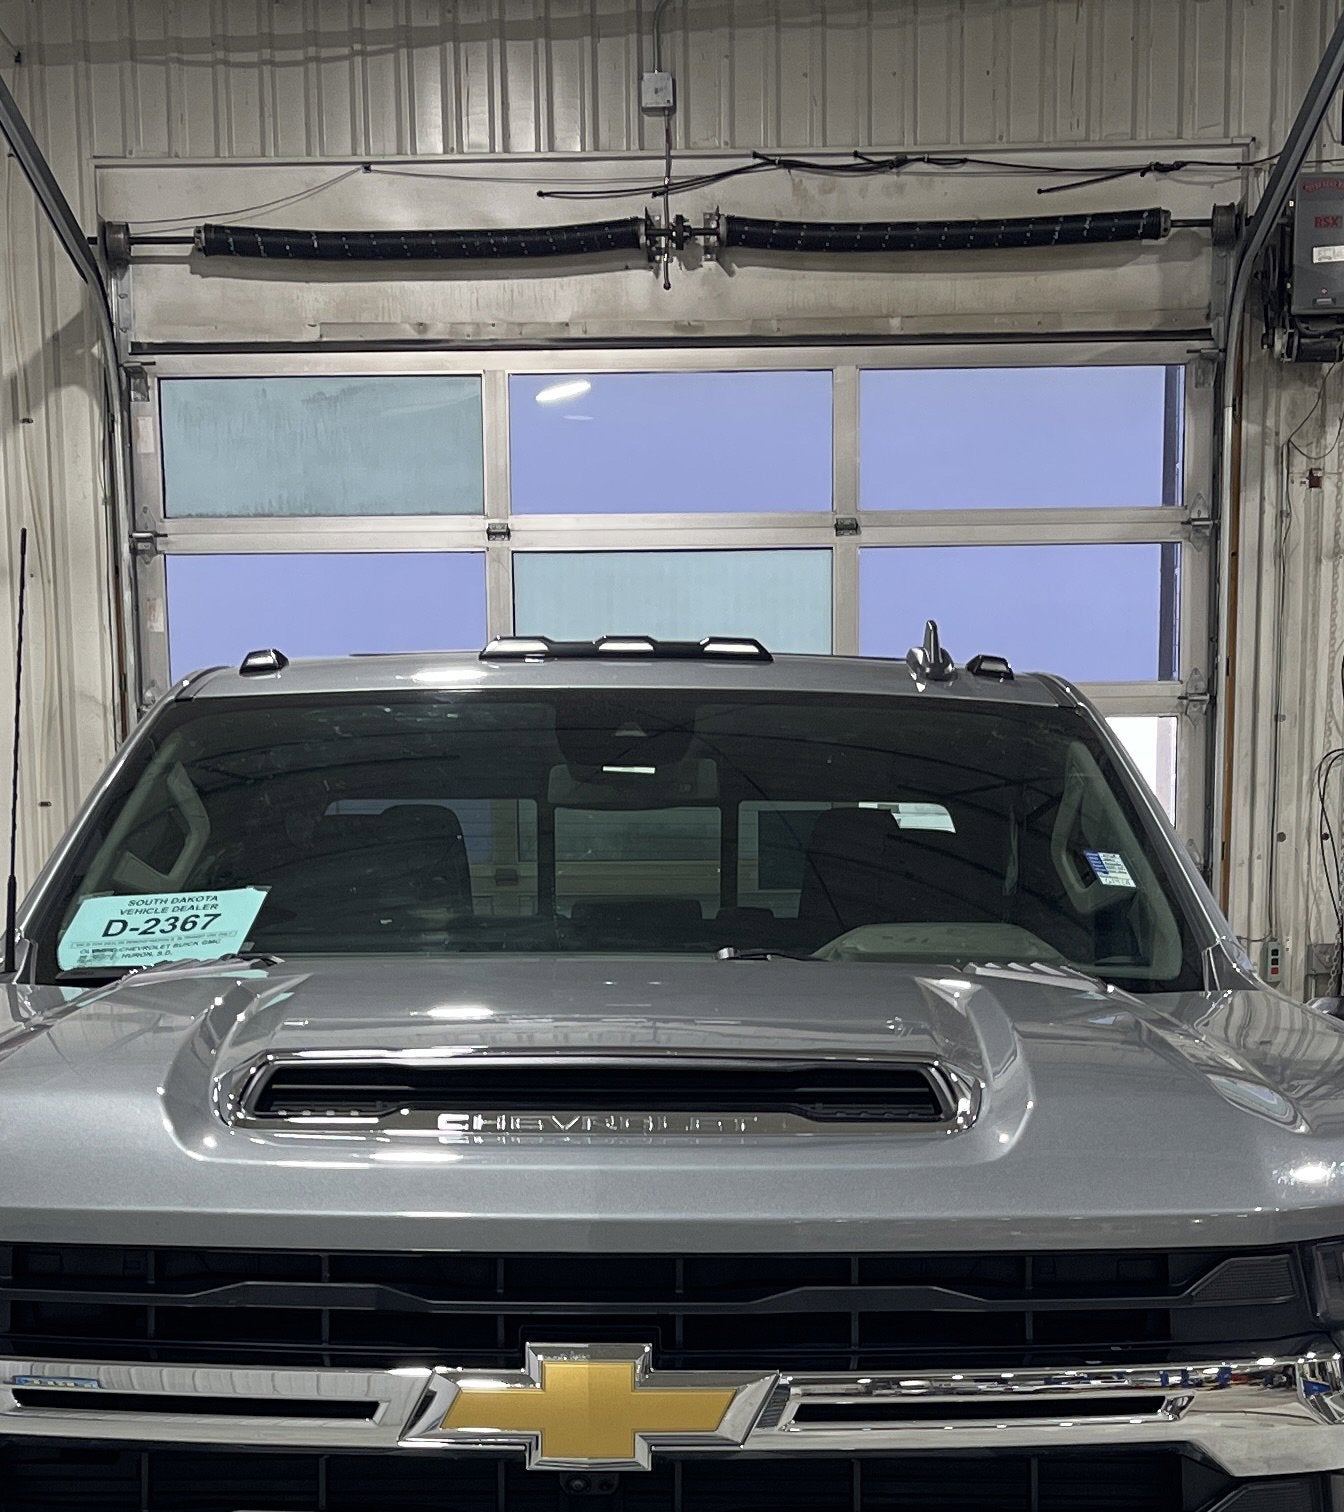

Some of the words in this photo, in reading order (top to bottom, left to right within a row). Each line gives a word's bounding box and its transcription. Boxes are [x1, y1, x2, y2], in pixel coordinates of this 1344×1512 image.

[128, 897, 168, 907] SOUTH
[171, 895, 218, 906] DAKOTA
[120, 906, 169, 916] VEHICLE
[172, 904, 219, 913] DEALER
[102, 913, 222, 938] D-2367
